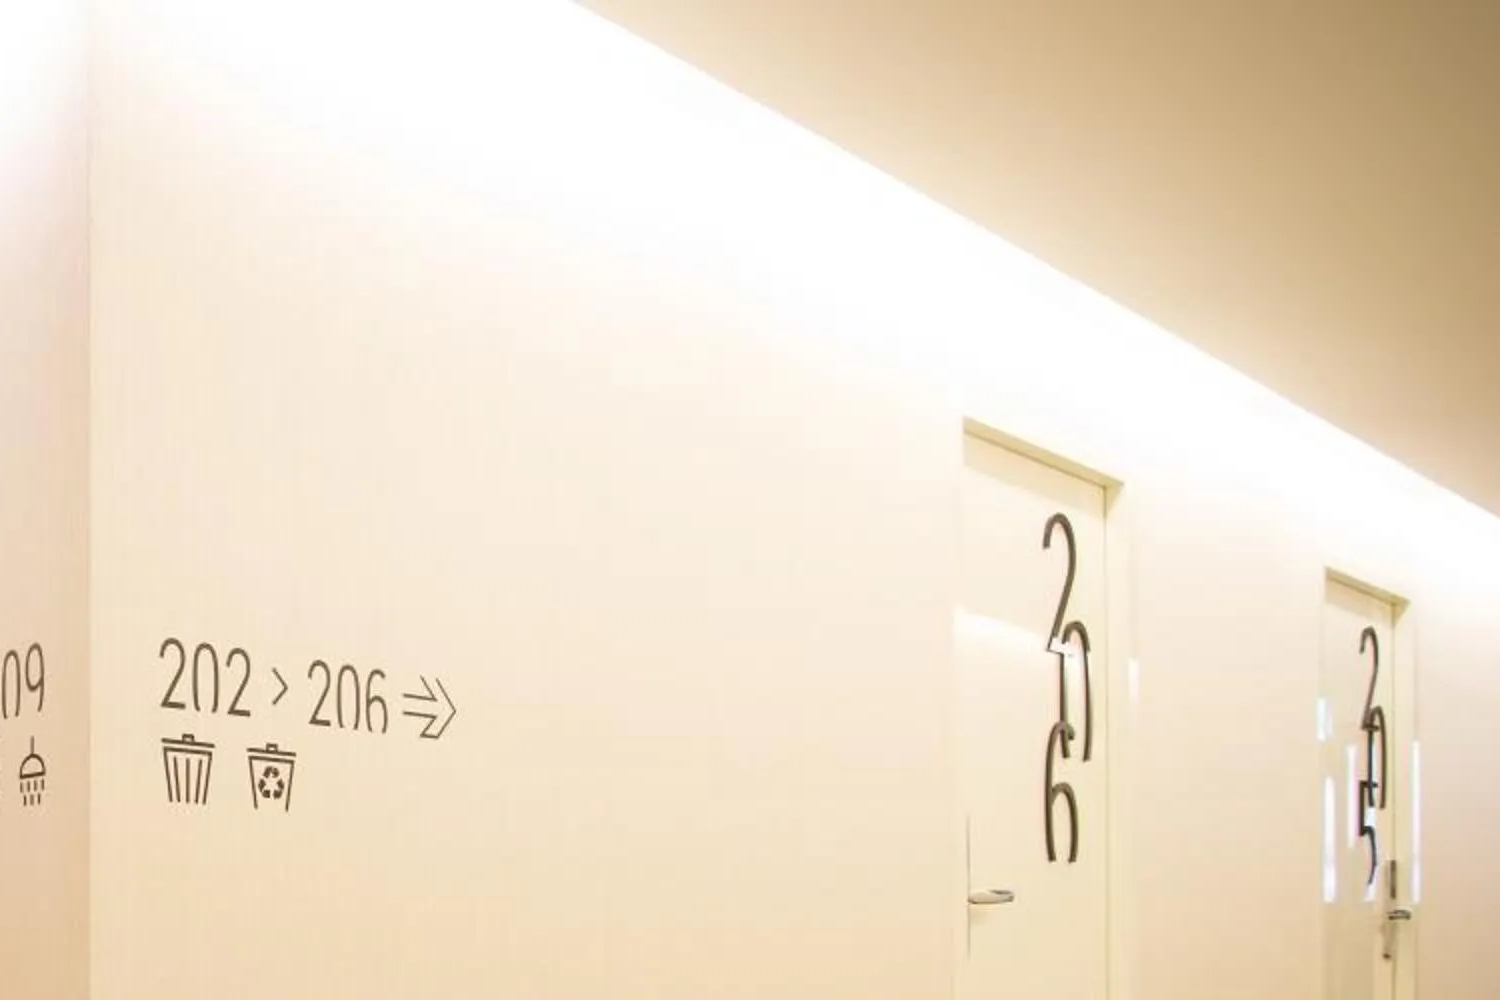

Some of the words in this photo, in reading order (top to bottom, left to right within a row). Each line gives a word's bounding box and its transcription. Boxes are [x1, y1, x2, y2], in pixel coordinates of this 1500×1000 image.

[159, 637, 252, 717] 202
[307, 659, 389, 734] 206
[1042, 512, 1092, 863] 206
